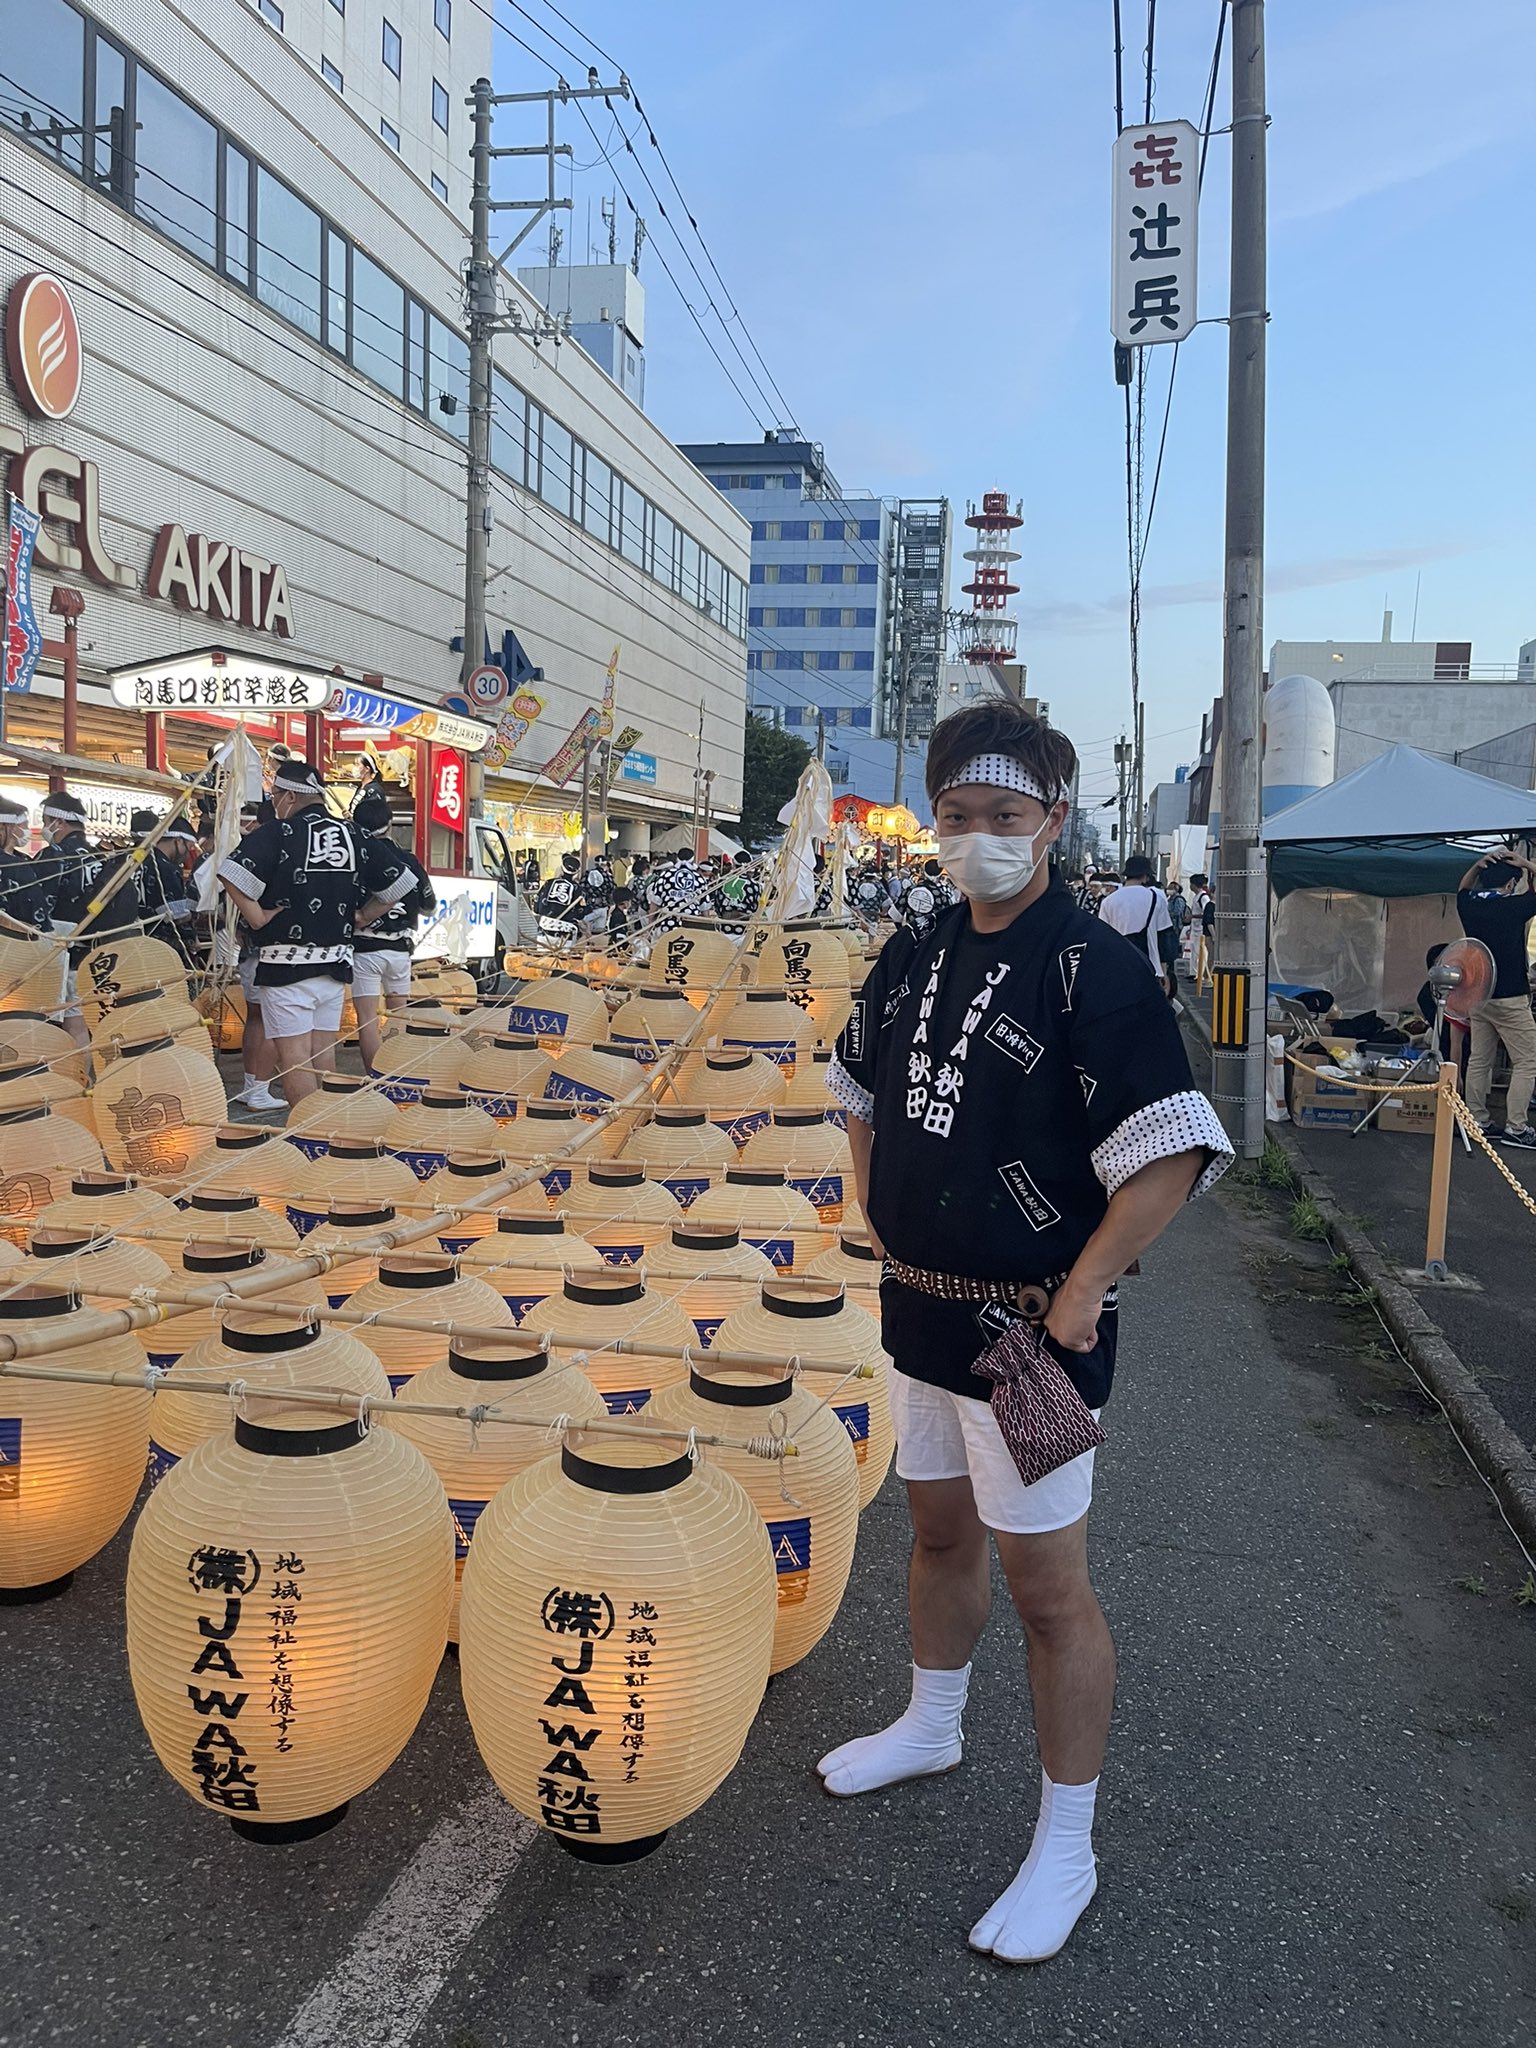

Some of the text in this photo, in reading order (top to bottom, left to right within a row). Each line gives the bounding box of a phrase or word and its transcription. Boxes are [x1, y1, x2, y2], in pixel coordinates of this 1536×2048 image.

[156, 523, 296, 639] AKITA
[337, 692, 399, 728] SALASA
[478, 678, 500, 695] 30
[437, 765, 461, 819] 馬
[308, 826, 349, 868] 馬
[551, 884, 569, 904] 馬
[906, 948, 946, 1119] JAWA秋田
[923, 962, 1011, 1138] JAWA秋田
[1009, 1169, 1049, 1222] JAWA秋田
[265, 1550, 306, 1753] 地域福祉を想像する
